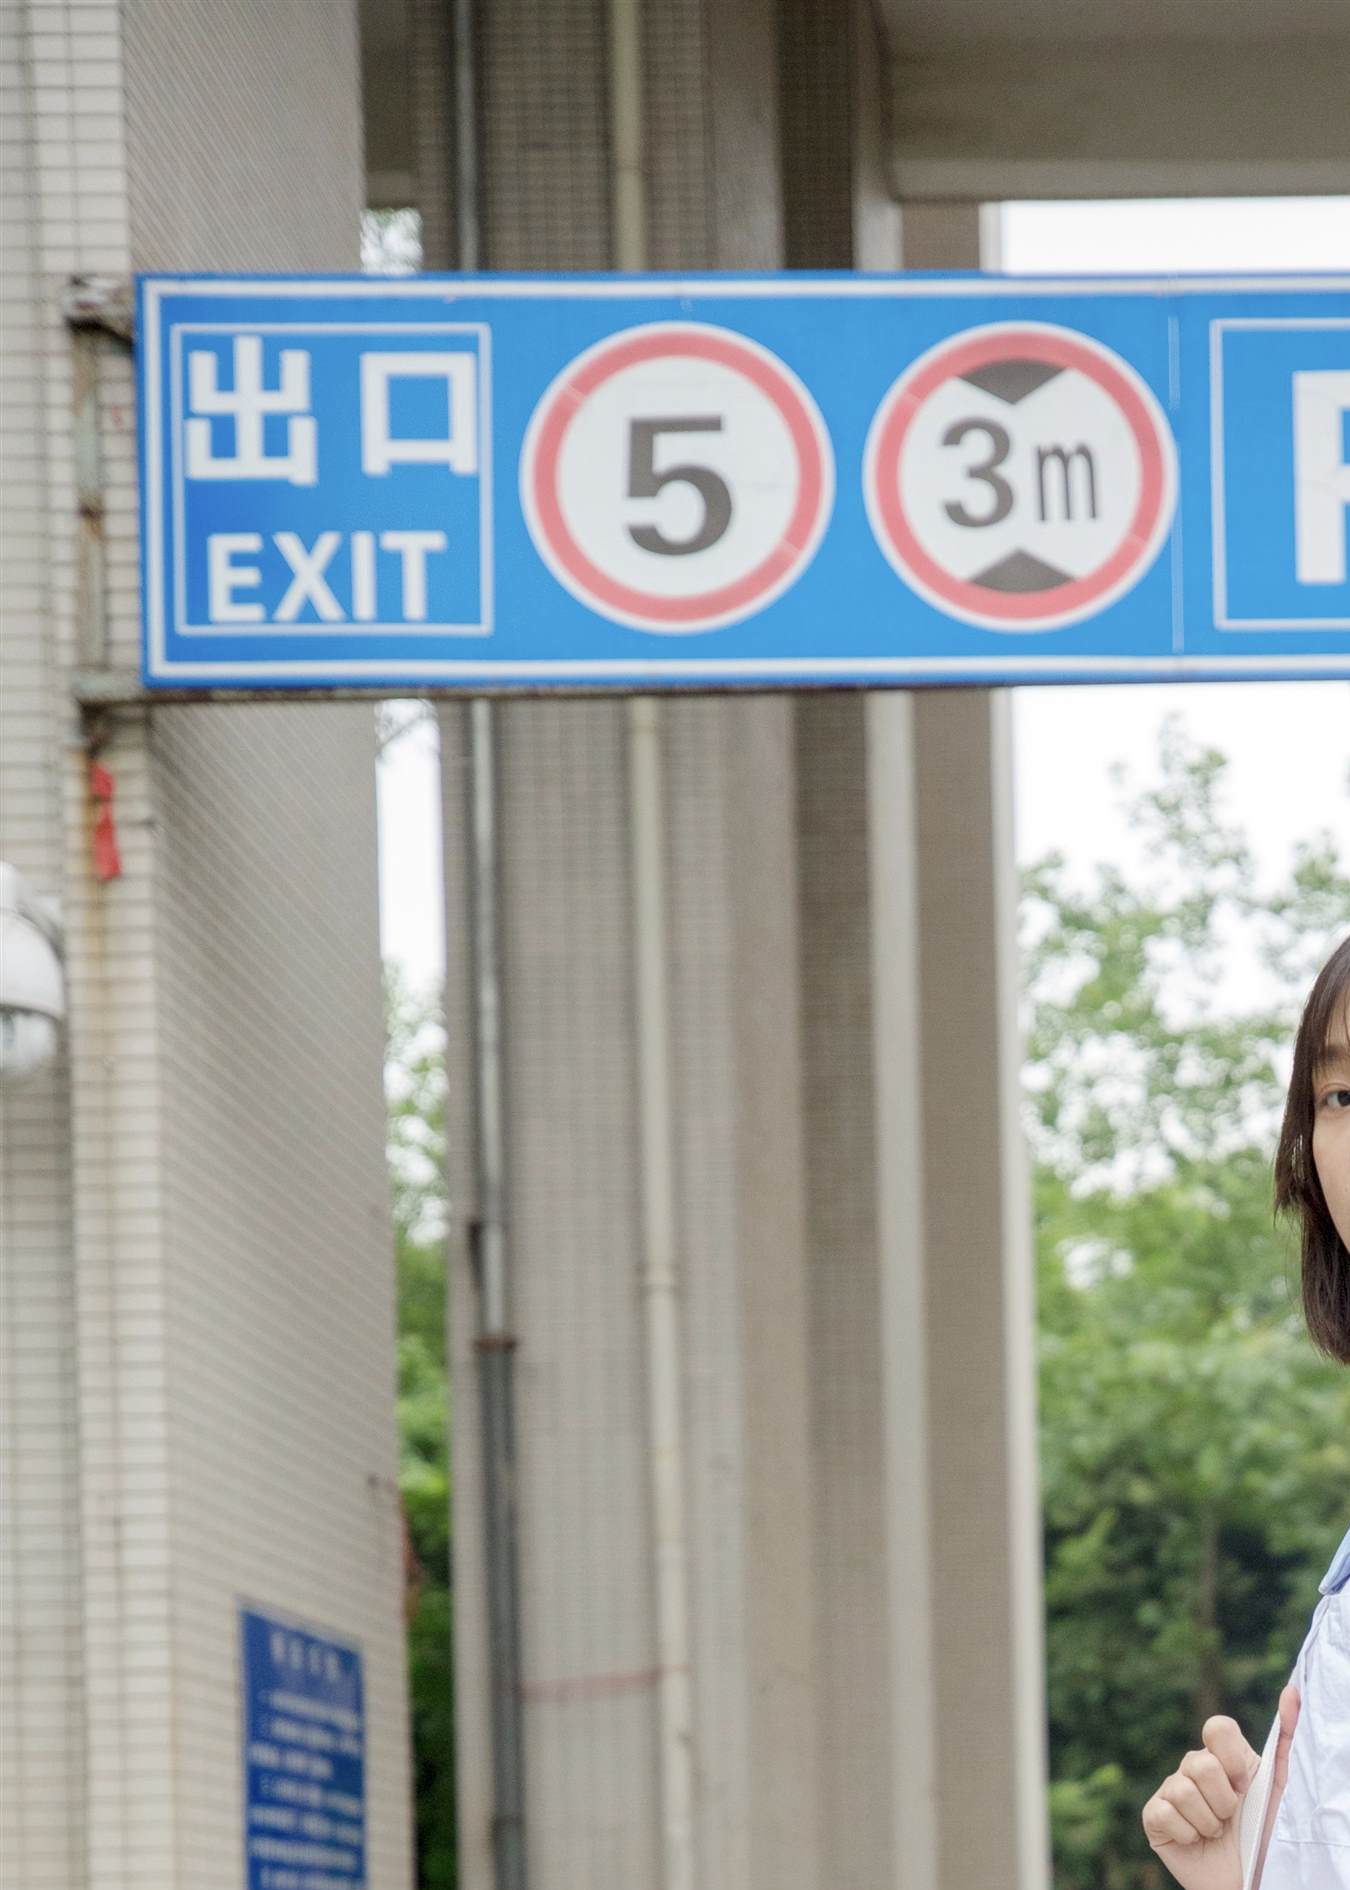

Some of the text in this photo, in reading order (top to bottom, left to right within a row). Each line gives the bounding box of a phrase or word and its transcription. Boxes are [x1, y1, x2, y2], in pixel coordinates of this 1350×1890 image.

[184, 333, 478, 485] 出口
[625, 415, 734, 558] 5
[207, 531, 447, 624] EXIT
